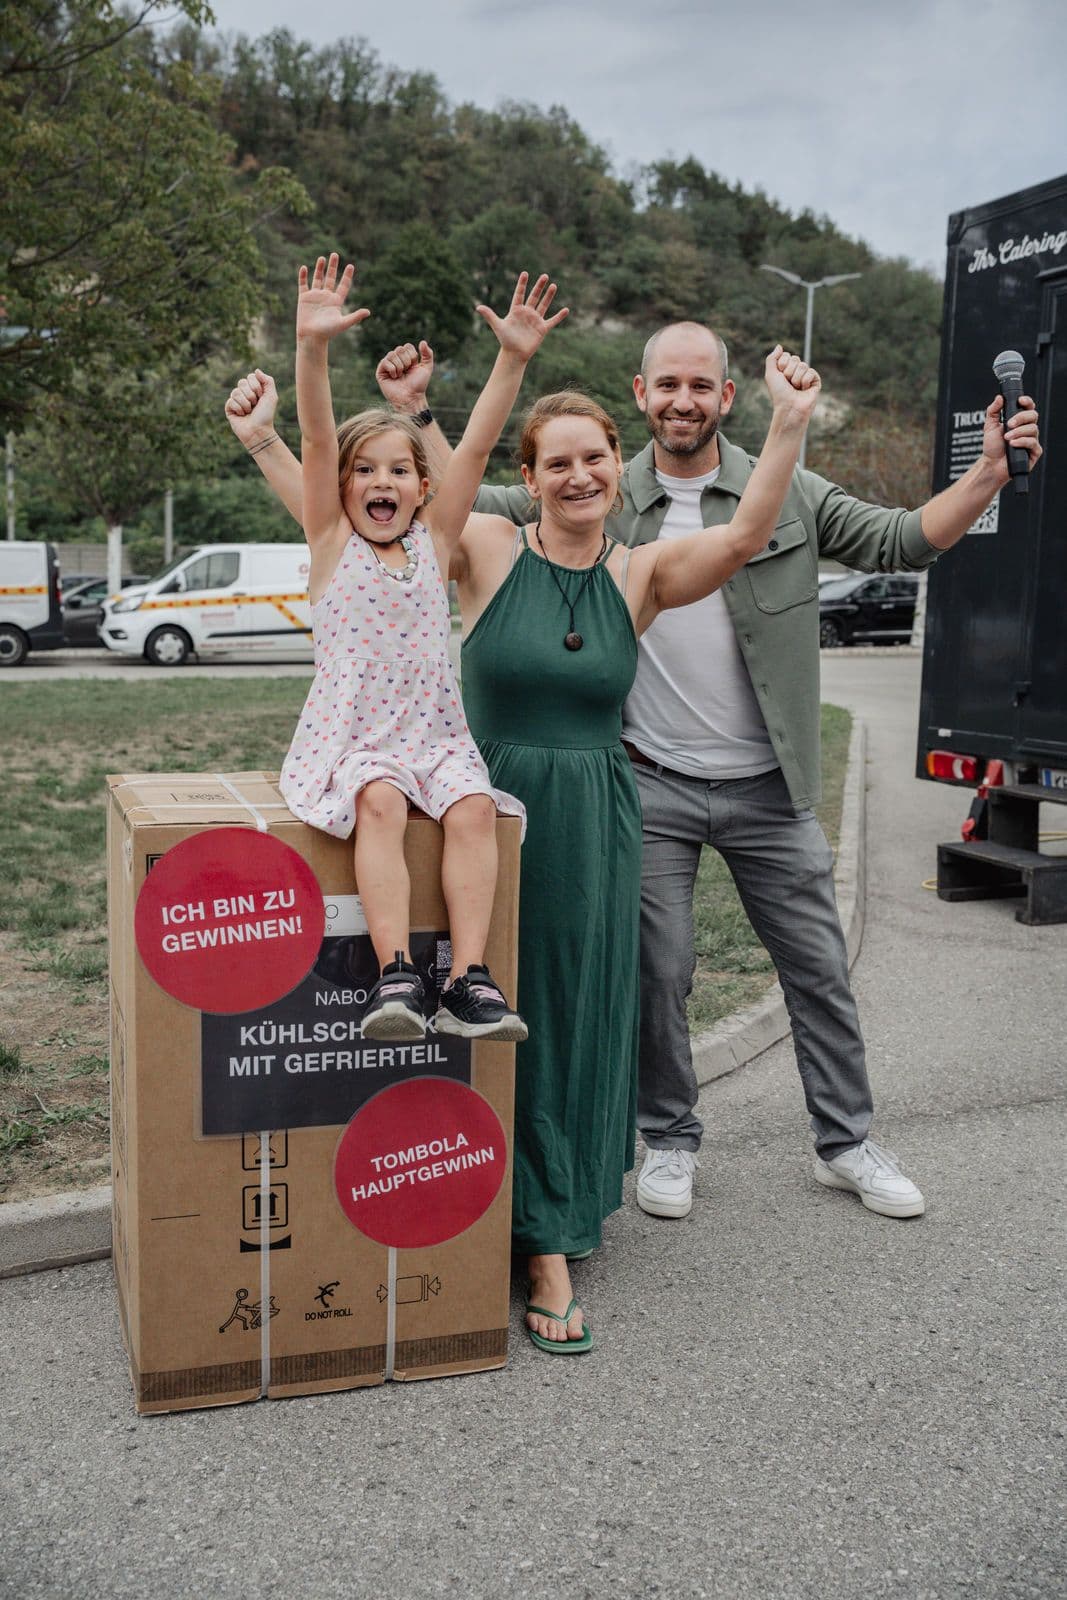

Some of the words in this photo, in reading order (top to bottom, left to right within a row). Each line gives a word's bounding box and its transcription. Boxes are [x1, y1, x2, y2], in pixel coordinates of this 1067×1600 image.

[999, 229, 1067, 264] Catering
[161, 901, 206, 926] ICH
[213, 894, 256, 918] BIN
[262, 888, 296, 911] ZU
[161, 915, 303, 954] GEWINNEN!
[315, 988, 368, 1006] NABO
[229, 1054, 276, 1077] MIT
[284, 1043, 449, 1074] GEFRIERTEIL
[370, 1132, 470, 1173] TOMBOLA
[351, 1146, 496, 1202] HAUPTGEWINN
[304, 1311, 317, 1321] DO
[317, 1310, 333, 1320] NOT
[333, 1307, 354, 1318] ROLL
